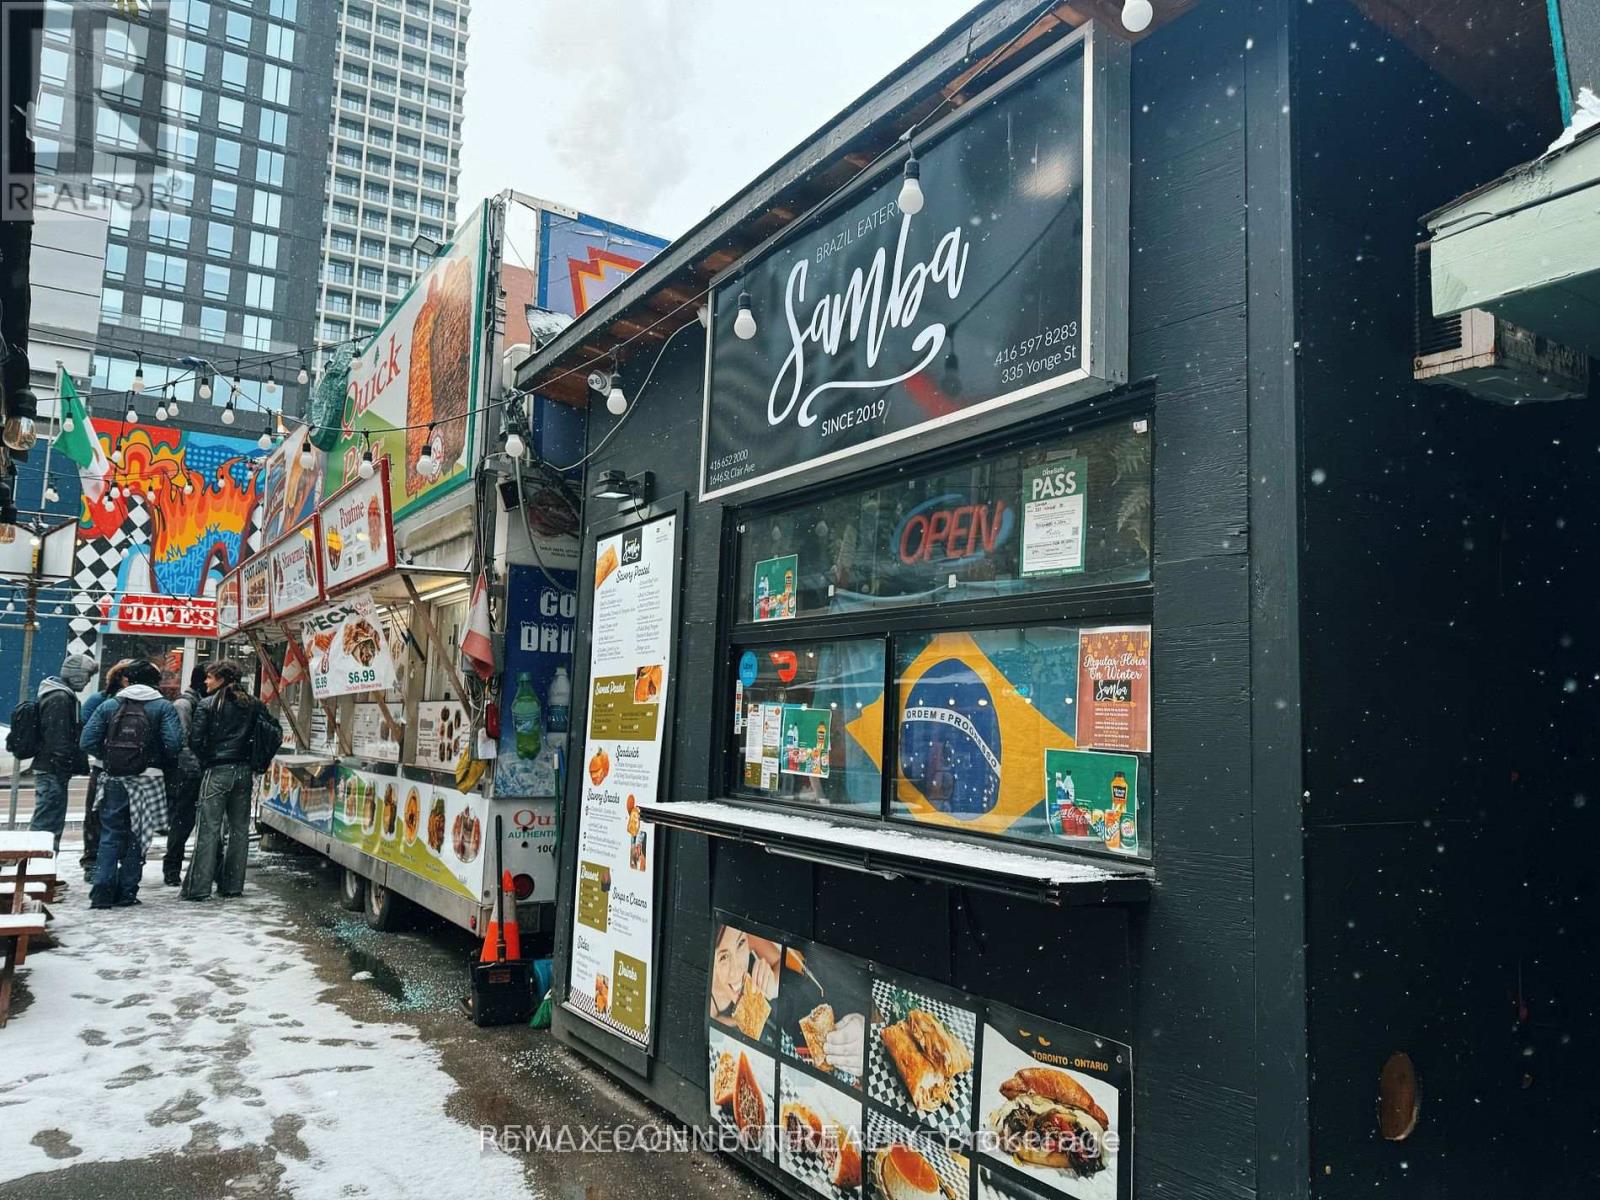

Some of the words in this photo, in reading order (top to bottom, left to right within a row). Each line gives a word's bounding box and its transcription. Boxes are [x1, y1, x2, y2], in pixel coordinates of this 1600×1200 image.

[816, 228, 853, 264] BRAZIL
[995, 345, 1018, 365] 416
[1020, 335, 1043, 356] 597
[1044, 321, 1077, 346] 8283
[1002, 364, 1023, 383] 335
[1026, 353, 1061, 374] Yonge
[1064, 344, 1077, 361] St
[341, 332, 402, 443] Quick
[821, 420, 854, 437] SINCE
[855, 399, 886, 425] 2019
[709, 459, 721, 471] 416
[721, 454, 733, 468] 652
[732, 449, 749, 464] 2000
[709, 473, 724, 486] 1646
[730, 465, 744, 479] Clair
[1032, 471, 1076, 500] PASS
[898, 500, 1005, 565] OPEN
[633, 562, 651, 580] Pastel
[128, 605, 216, 630] DAVE'S
[520, 620, 575, 653] DRI
[1083, 654, 1118, 670] Regular
[1119, 652, 1147, 667] Hour
[348, 669, 375, 684] $6.99
[1105, 665, 1142, 682] Winter
[610, 681, 626, 694] Pastel
[906, 710, 937, 719] ORDEM
[940, 713, 946, 721] E
[616, 744, 640, 761] Sandwich
[513, 809, 556, 831] Qu
[618, 960, 637, 981] Drinks
[1031, 1050, 1068, 1065] TORONTO
[1074, 1058, 1109, 1072] ONTARIO
